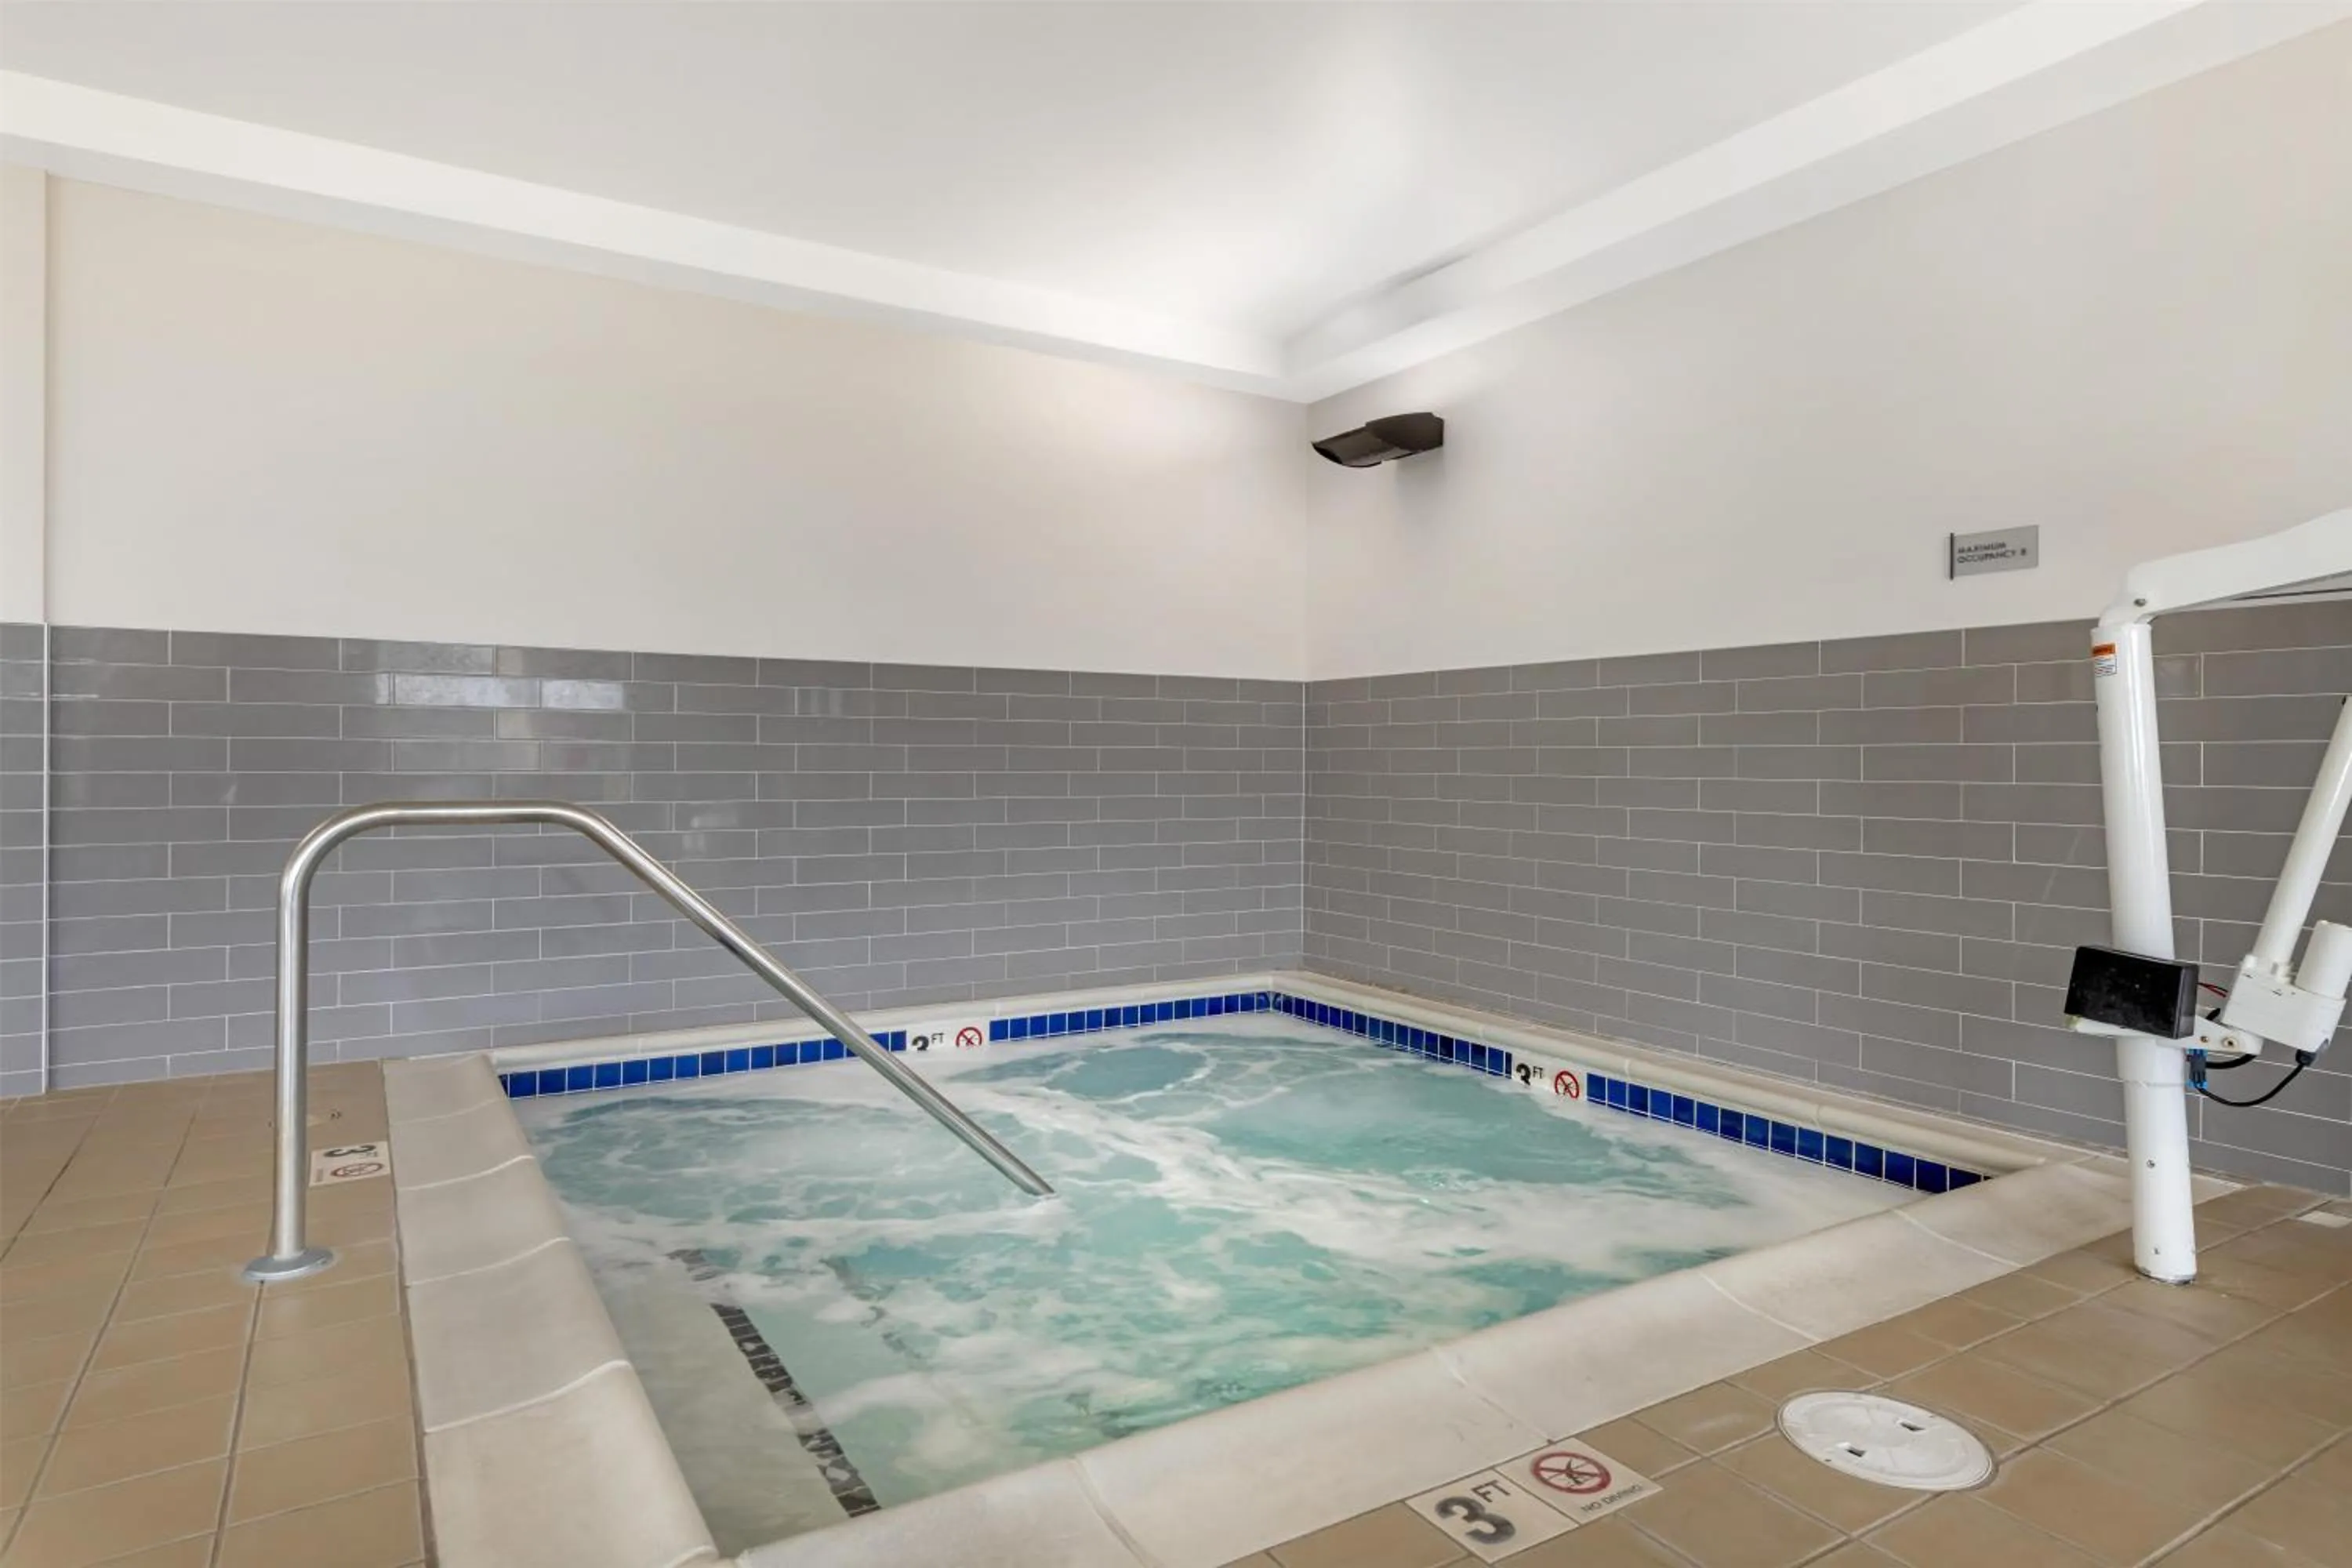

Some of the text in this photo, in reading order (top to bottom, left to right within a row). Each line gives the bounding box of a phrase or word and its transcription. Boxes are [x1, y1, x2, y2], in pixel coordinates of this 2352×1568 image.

[1958, 542, 2006, 554] MAXIMUM
[1957, 550, 2016, 564] OCCUPANCY
[931, 1032, 945, 1044] FT
[1533, 1066, 1544, 1080] FT
[1581, 1483, 1644, 1512] NO DIVING
[1435, 1479, 1516, 1544] 3 FT
